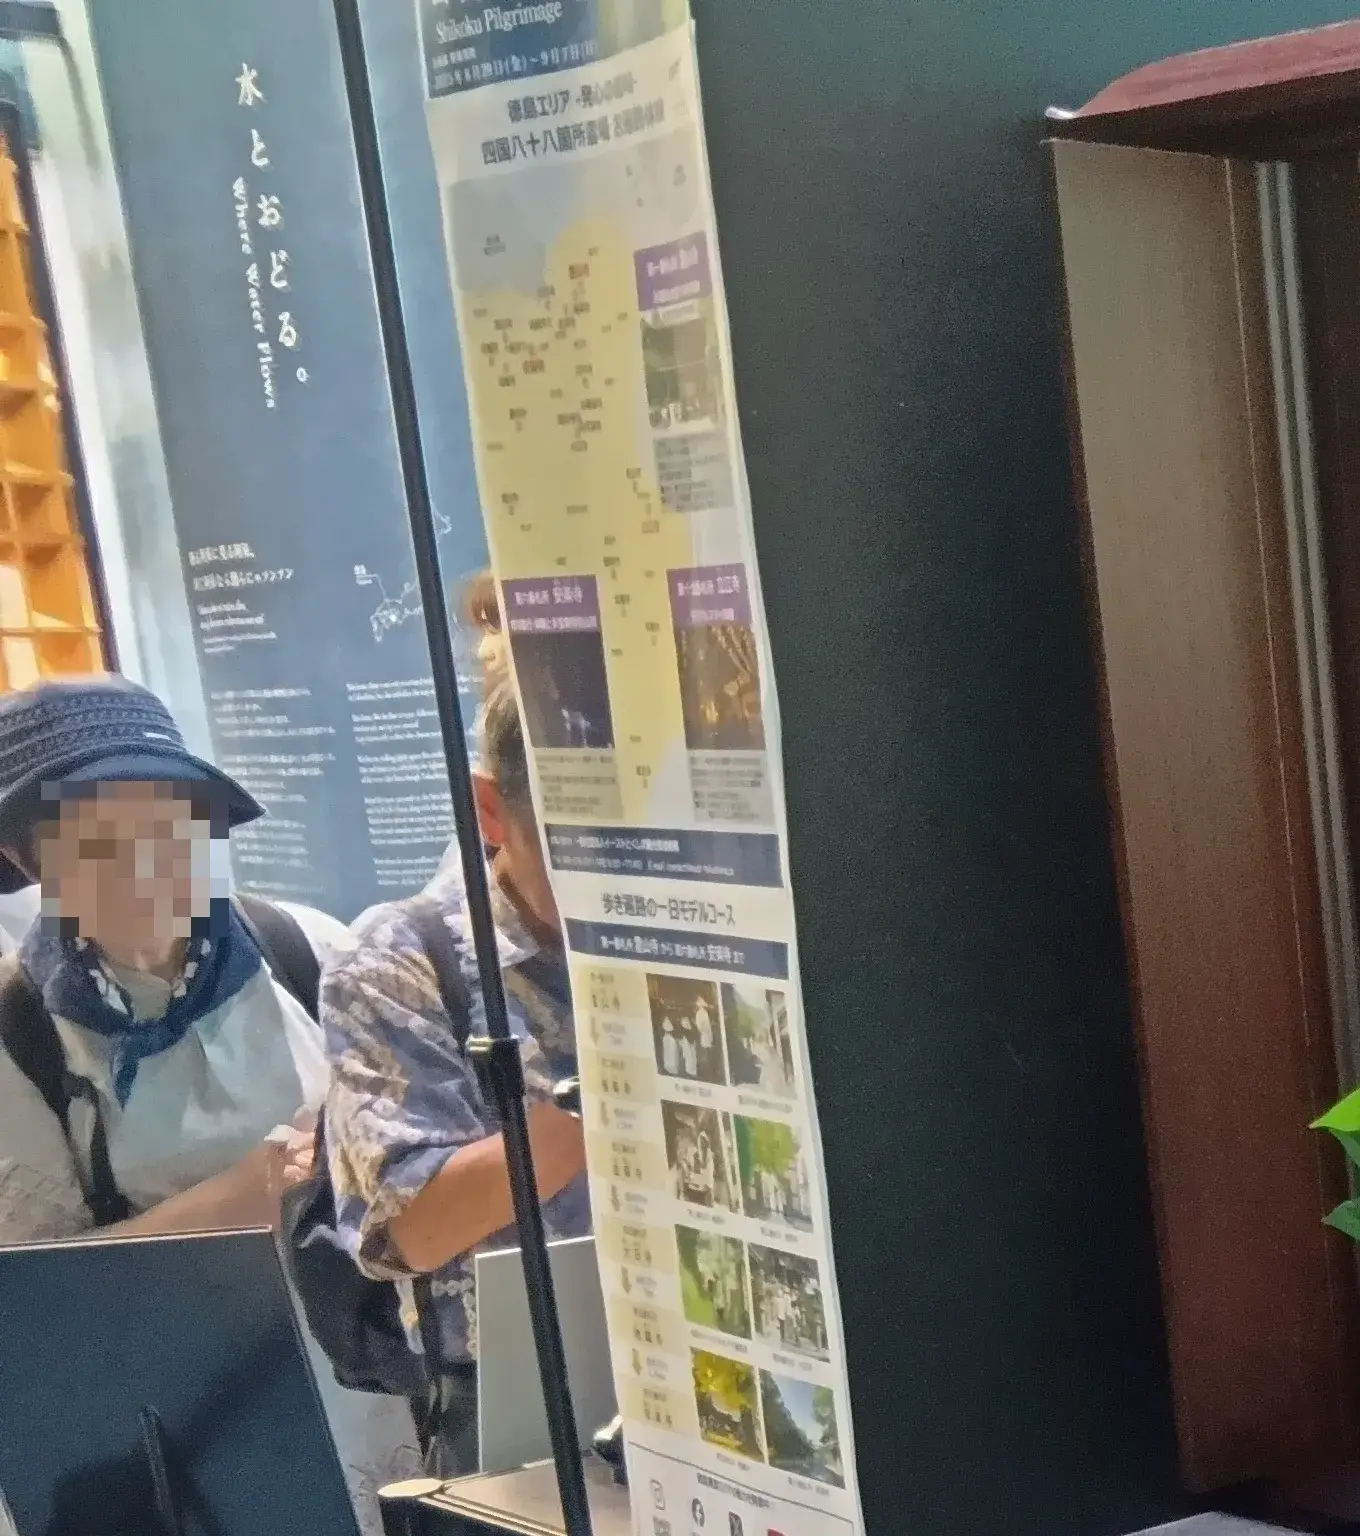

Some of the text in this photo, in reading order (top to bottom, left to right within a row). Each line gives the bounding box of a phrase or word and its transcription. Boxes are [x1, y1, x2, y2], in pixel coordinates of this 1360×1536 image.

[483, 1, 563, 32] Pilgrimage
[235, 61, 310, 384] 水とおどる。
[246, 262, 261, 335] Water
[257, 341, 276, 408] Flows
